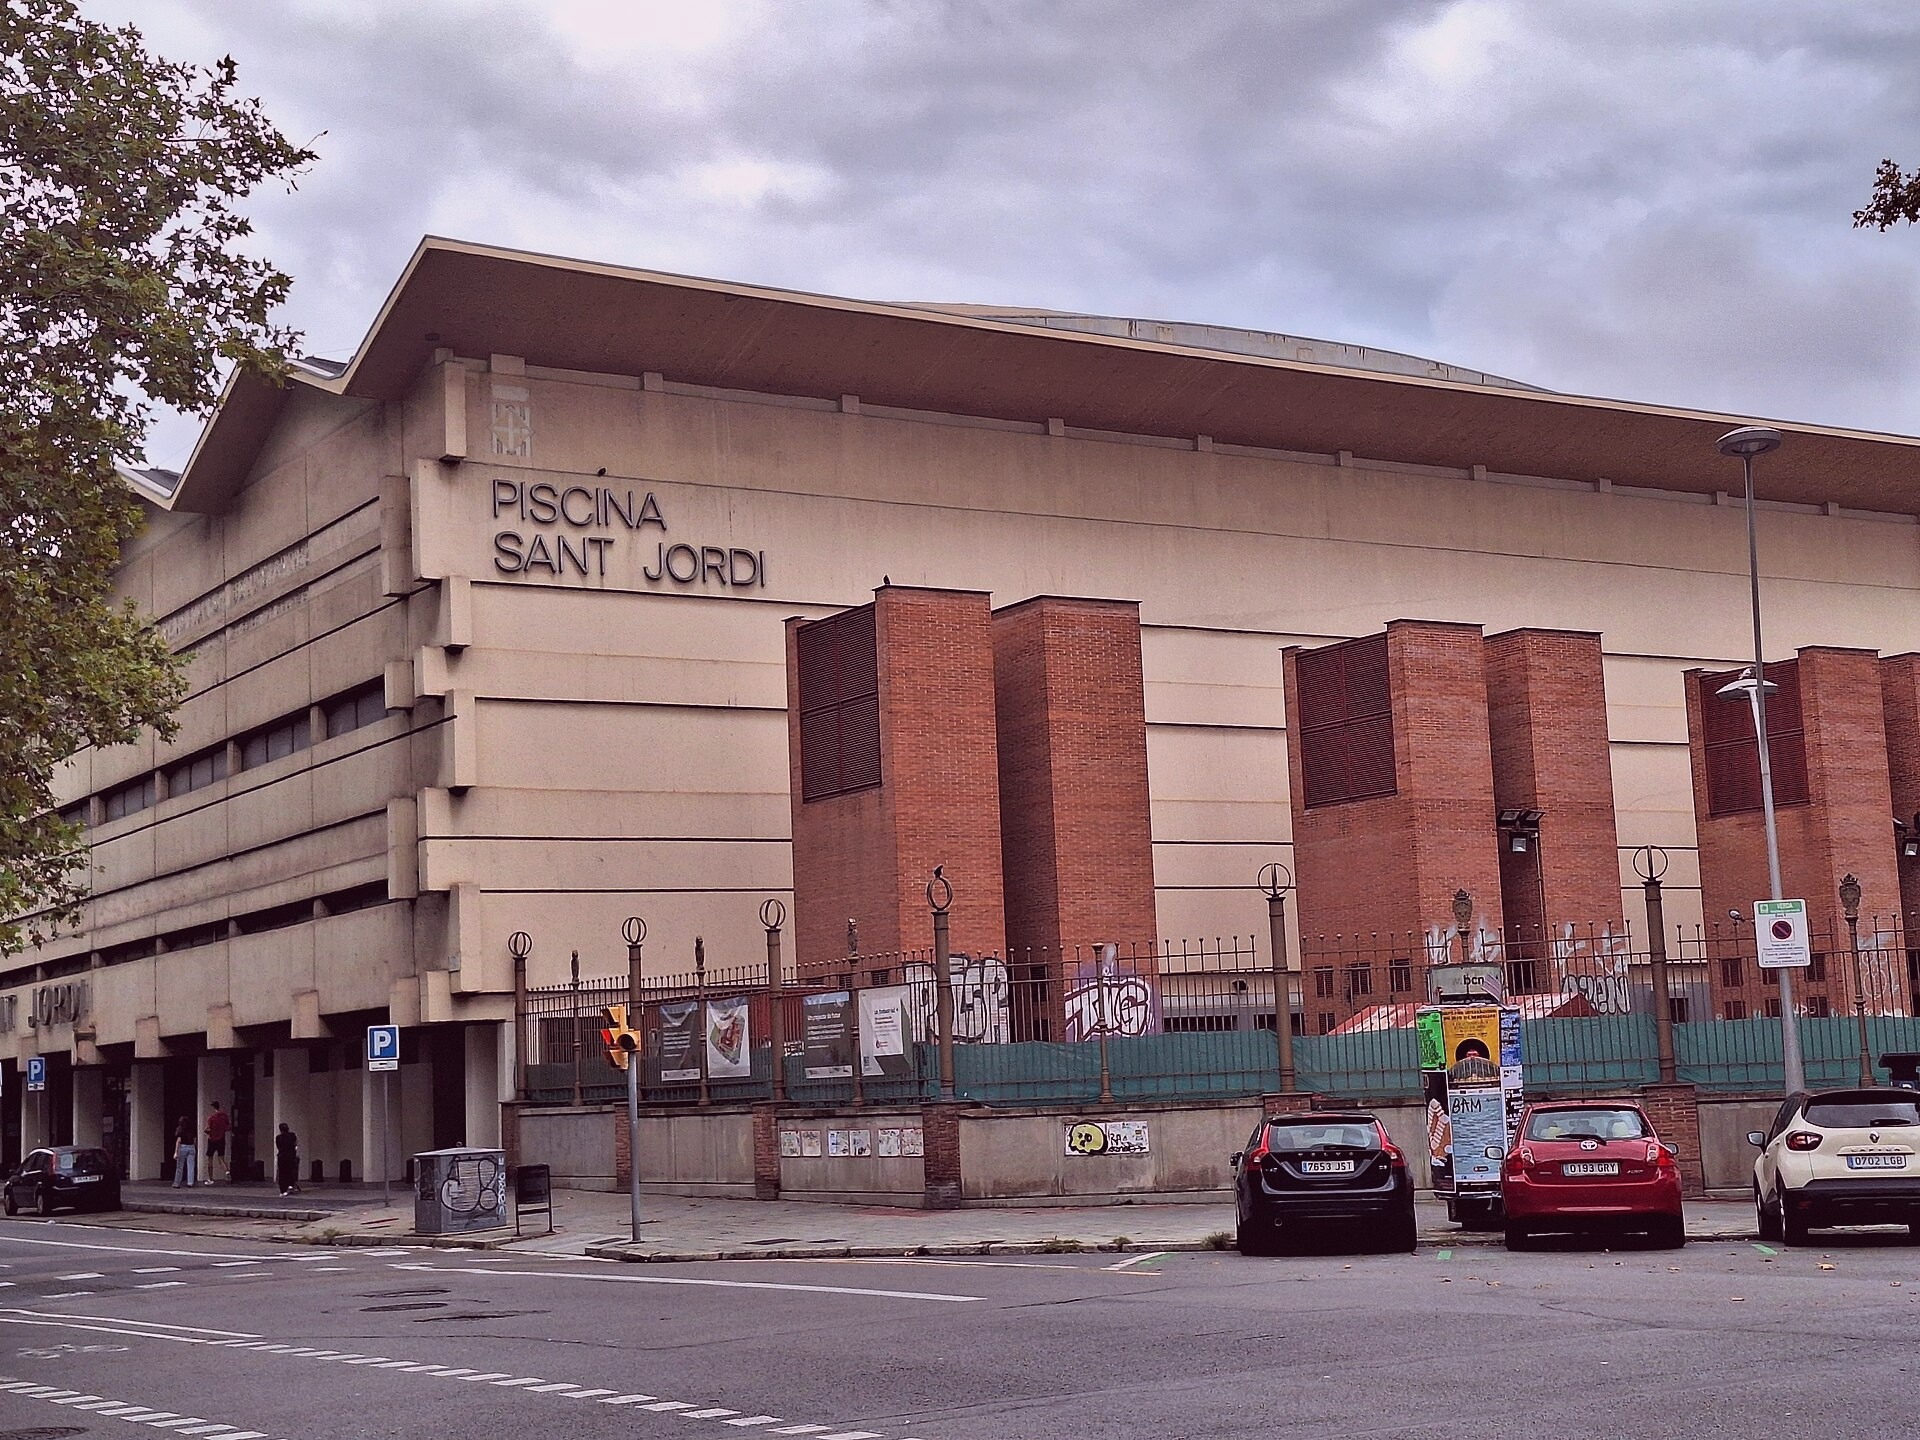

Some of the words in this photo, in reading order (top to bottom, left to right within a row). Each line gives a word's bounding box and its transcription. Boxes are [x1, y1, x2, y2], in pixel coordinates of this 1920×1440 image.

[492, 479, 667, 531] PISCINA
[493, 531, 615, 576] SANT
[643, 542, 767, 588] JORDI
[374, 1031, 391, 1056] P
[30, 1060, 42, 1081] P
[1452, 1097, 1482, 1114] BAM
[1308, 1161, 1332, 1171] 7653
[1335, 1161, 1352, 1171] JST
[1569, 1163, 1595, 1173] 0193
[1597, 1163, 1616, 1173] GRY
[1855, 1156, 1880, 1166] 0702
[1884, 1156, 1903, 1166] LGB
